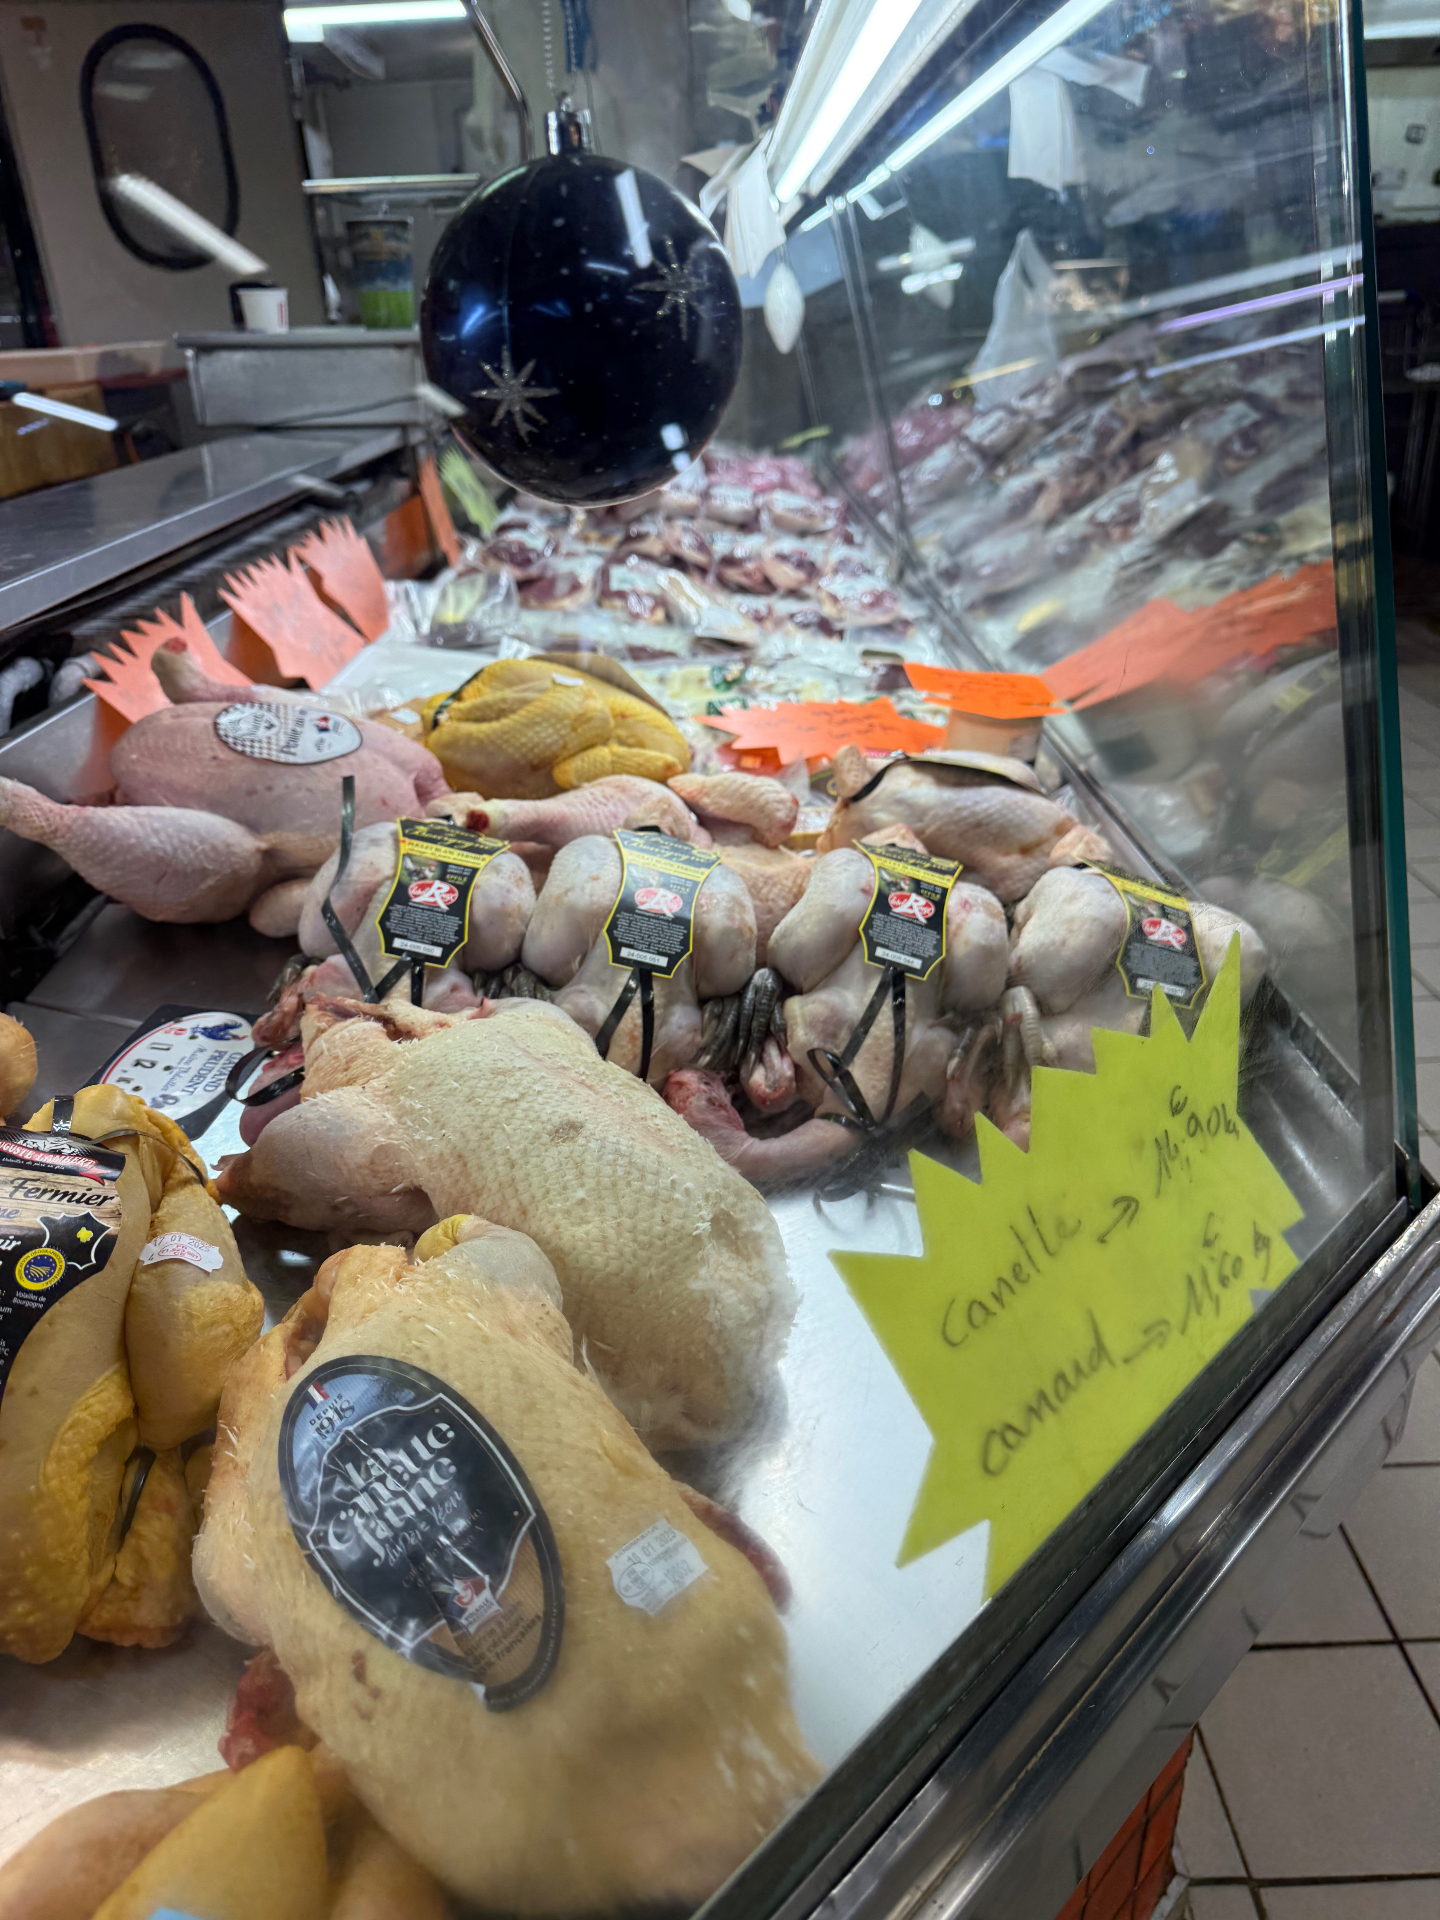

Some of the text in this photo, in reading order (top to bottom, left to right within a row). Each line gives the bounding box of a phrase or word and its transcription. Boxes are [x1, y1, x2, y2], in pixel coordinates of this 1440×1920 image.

[181, 1049, 230, 1096] PRUDENT
[204, 1051, 244, 1093] GAVAND
[0, 1141, 97, 1169] UGUSTE LAMBERT
[10, 1177, 116, 1208] Fermier
[12, 1296, 44, 1310] Bourgogne
[308, 1392, 344, 1427] DEPUIS
